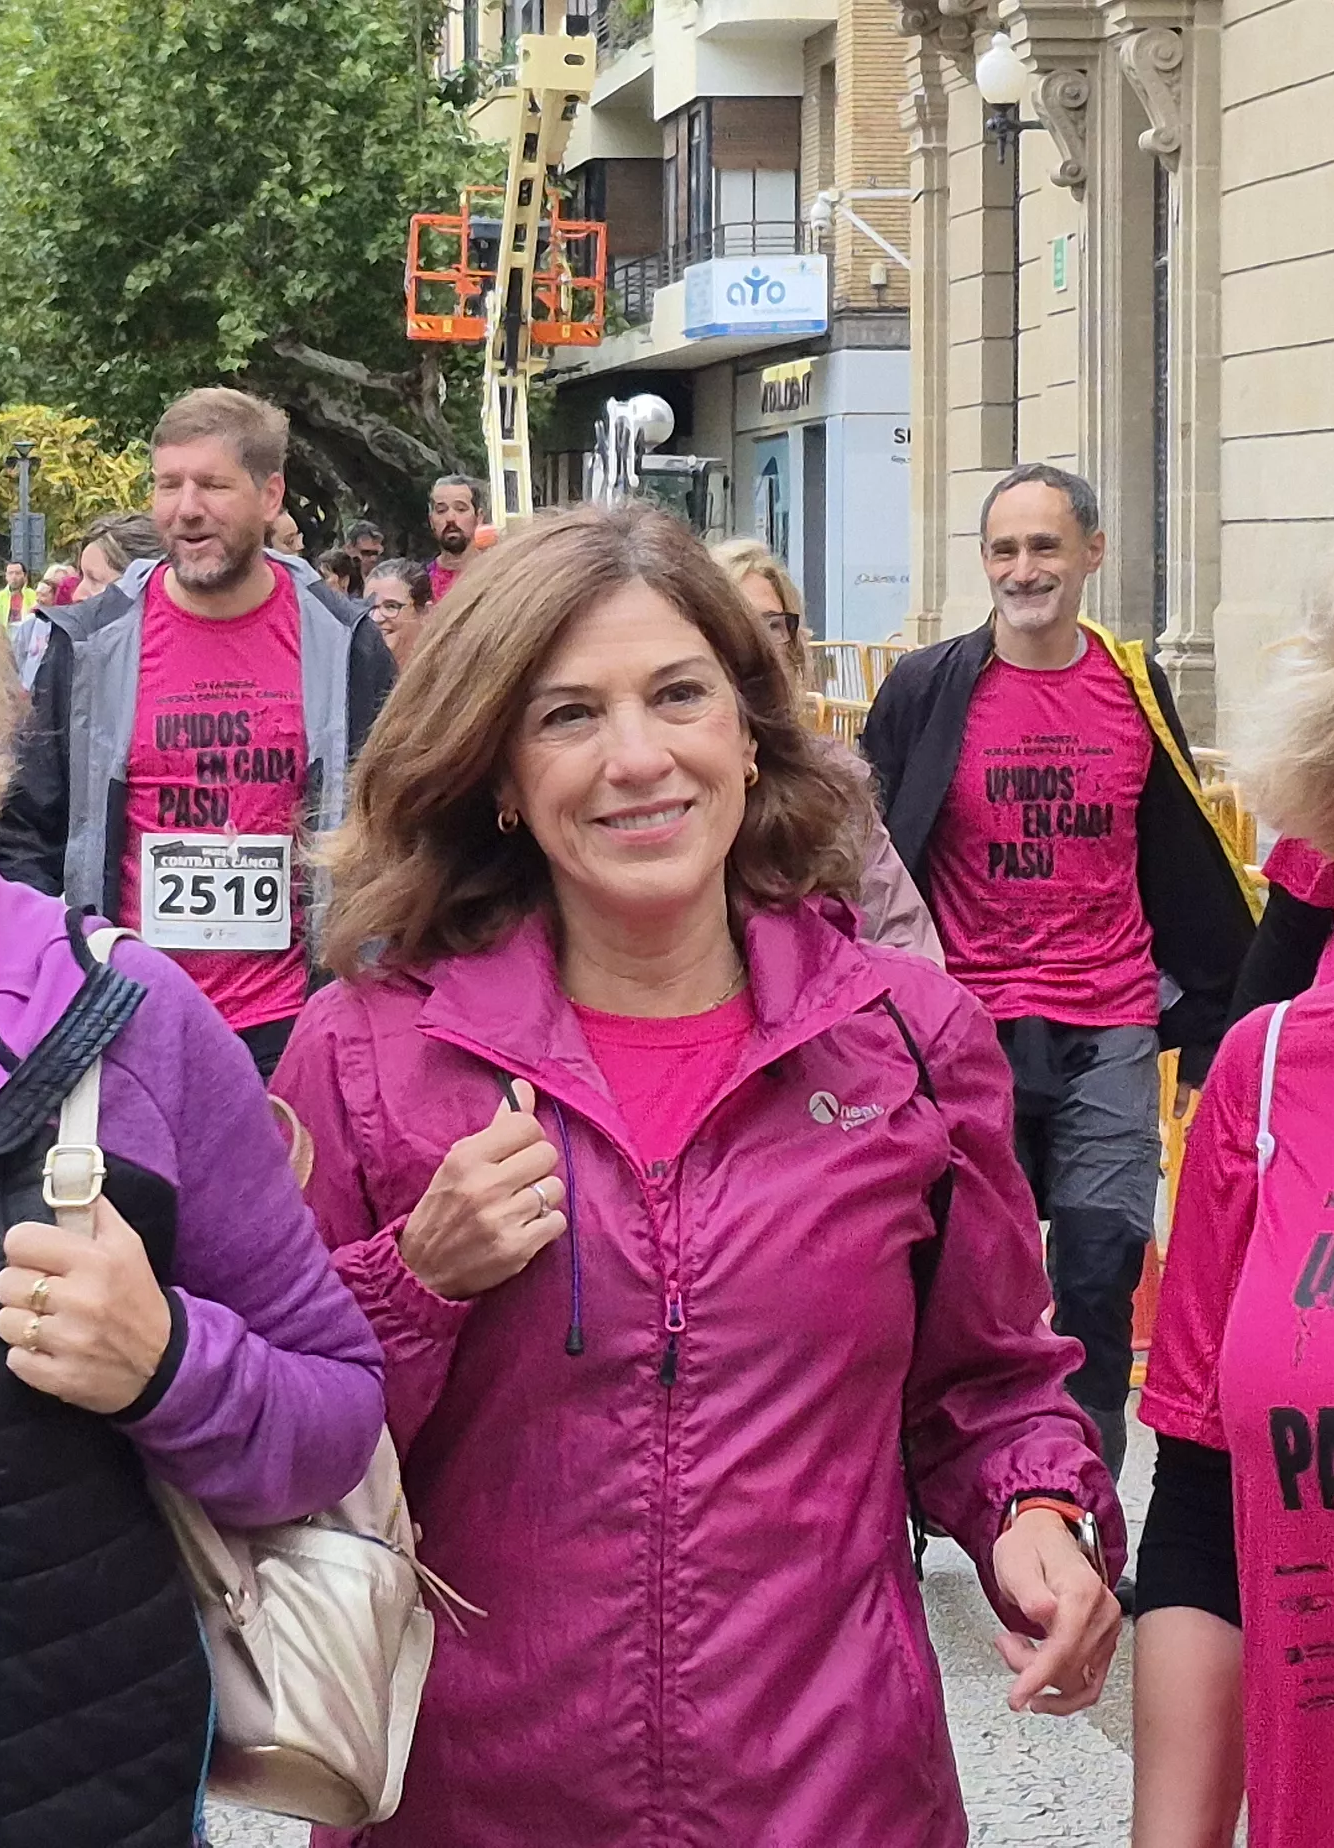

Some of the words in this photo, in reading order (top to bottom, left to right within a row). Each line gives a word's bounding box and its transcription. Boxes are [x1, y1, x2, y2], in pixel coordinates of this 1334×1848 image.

[156, 710, 251, 751] UNIDOS
[197, 750, 227, 785] EN
[233, 748, 297, 784] CADA
[985, 765, 1075, 803] UNIDOS
[157, 786, 230, 828] PASO
[1022, 803, 1053, 839] EN
[160, 856, 213, 869] CONTRA
[987, 841, 1055, 880] PASO
[158, 873, 279, 917] 2519
